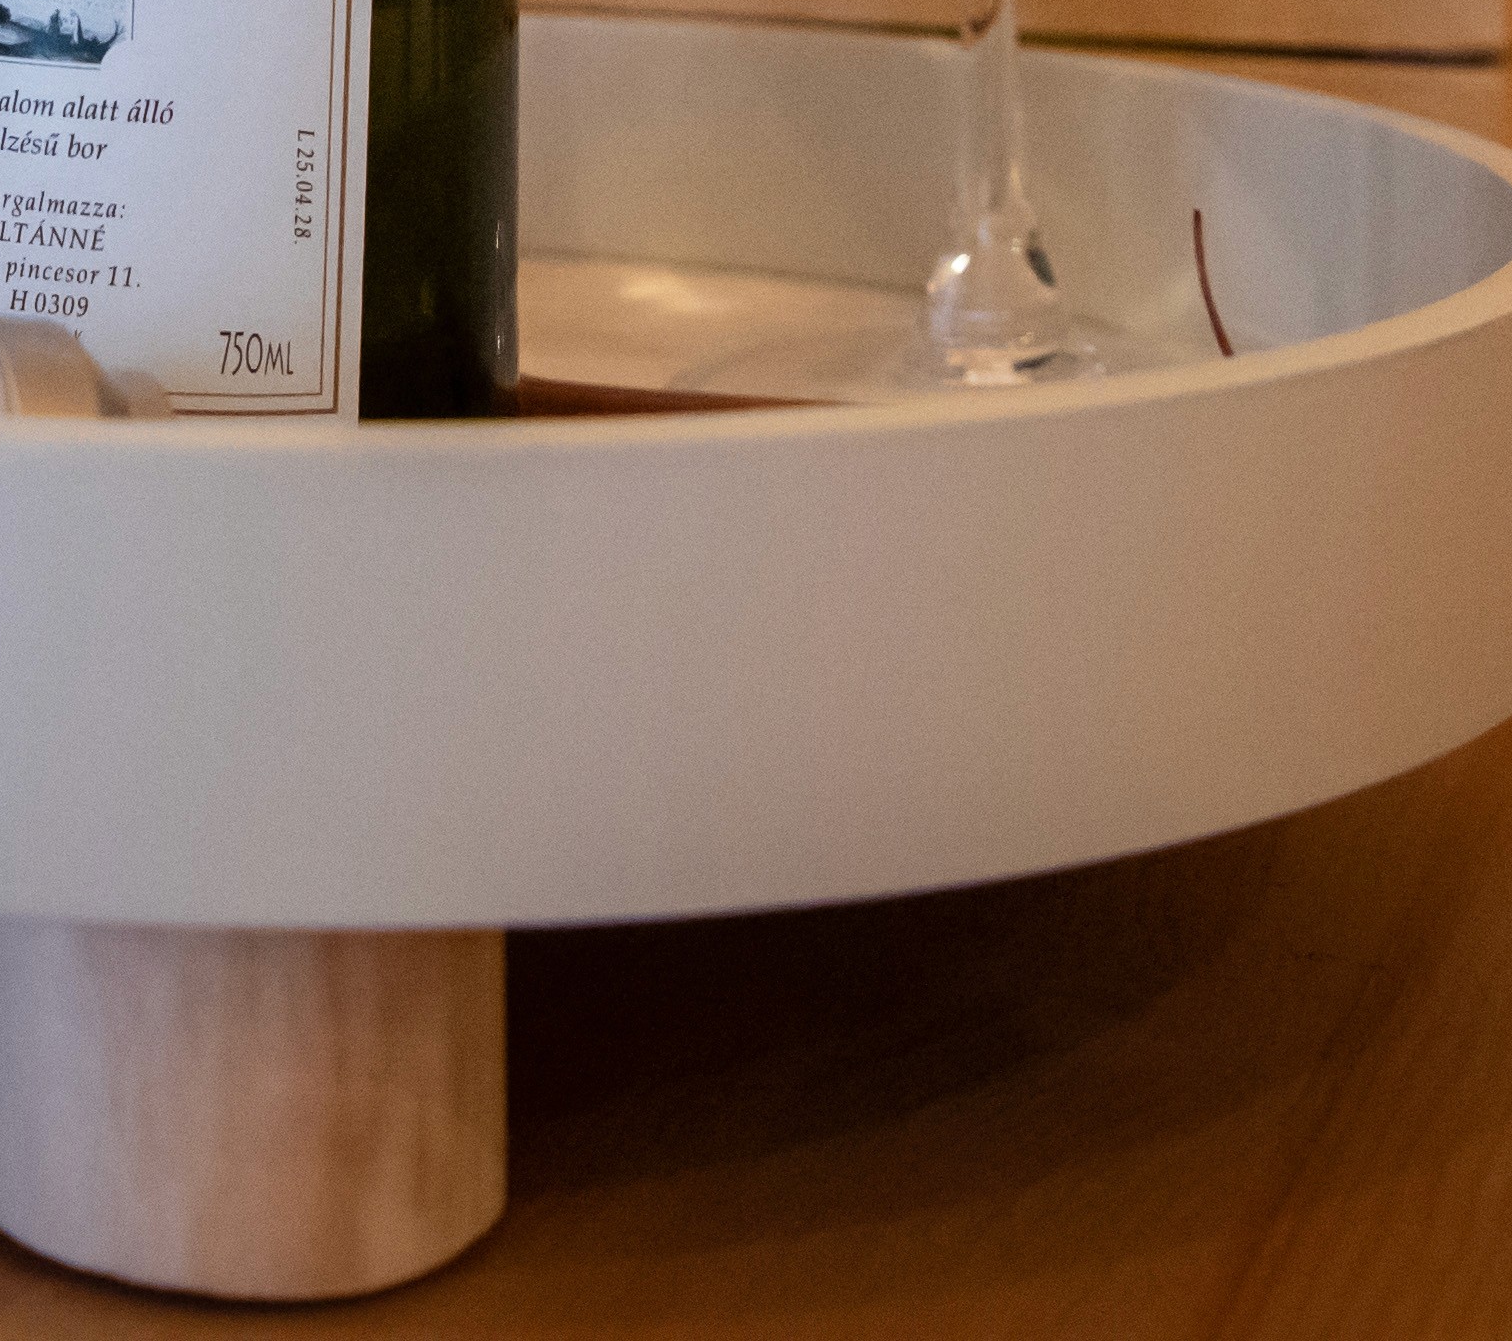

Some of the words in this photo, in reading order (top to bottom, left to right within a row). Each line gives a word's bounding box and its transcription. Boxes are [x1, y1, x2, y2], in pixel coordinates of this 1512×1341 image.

[62, 95, 120, 122] alatt
[127, 98, 175, 125] álló
[67, 133, 108, 160] bor
[5, 257, 100, 285] pincesor
[107, 265, 141, 288] 11.
[9, 289, 29, 311] H
[34, 292, 90, 318] 0309
[219, 330, 294, 376] 750ML
